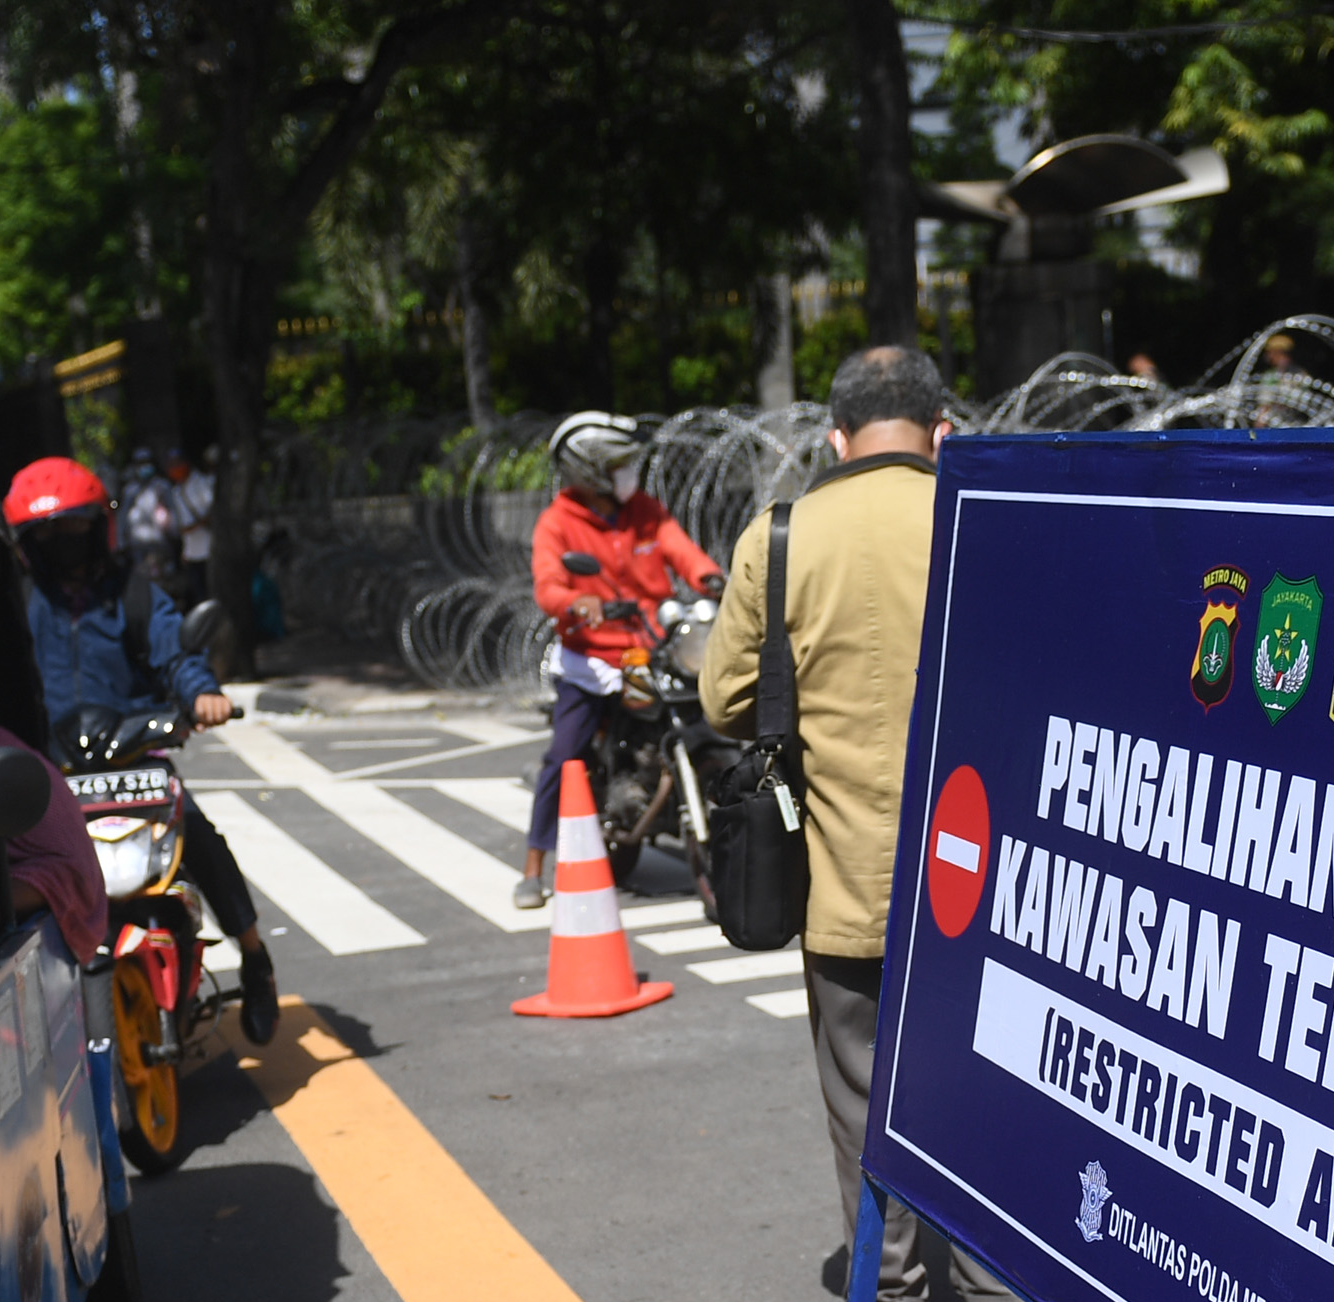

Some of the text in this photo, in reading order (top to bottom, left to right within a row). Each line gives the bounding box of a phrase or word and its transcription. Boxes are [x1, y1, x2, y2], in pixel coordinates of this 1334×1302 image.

[1203, 569, 1247, 594] METRO JAYA
[1272, 591, 1313, 611] JAYAKARTA
[990, 834, 1241, 1040] KAWASAN
[1038, 1006, 1285, 1209] (RESTRICTED
[1108, 1202, 1187, 1281] DITLANTAS
